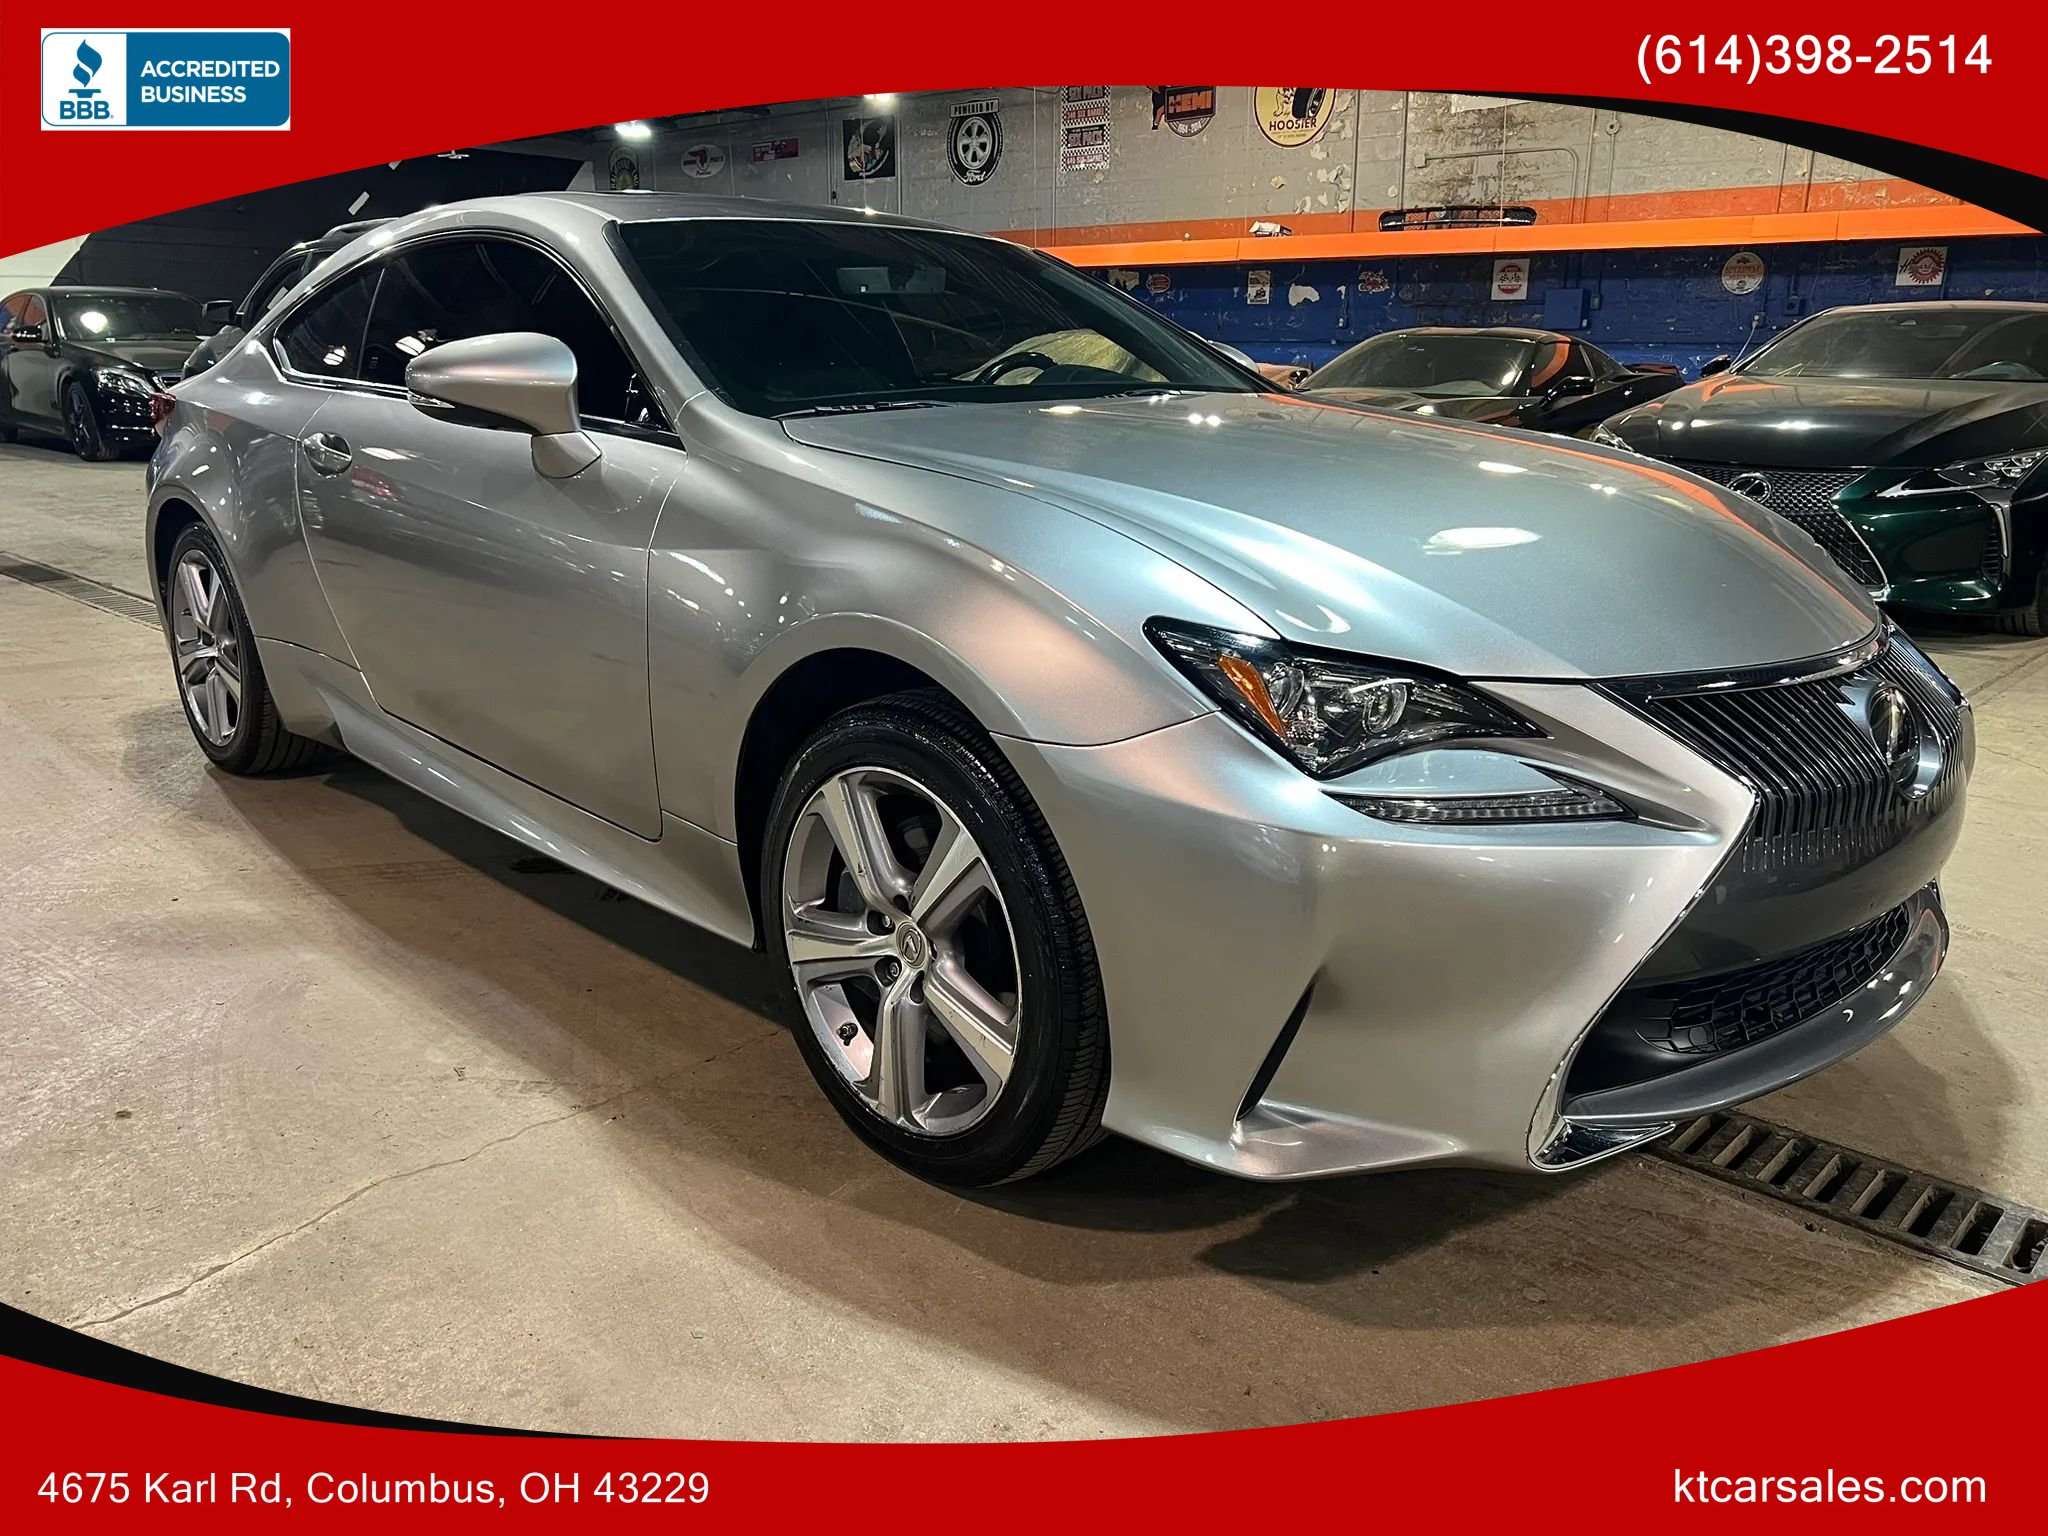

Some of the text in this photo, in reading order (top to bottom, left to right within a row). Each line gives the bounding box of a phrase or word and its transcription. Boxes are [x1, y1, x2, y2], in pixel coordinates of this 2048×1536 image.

[954, 101, 994, 115] POWERED BY
[1168, 90, 1212, 114] HEMI
[1269, 117, 1317, 131] HOOSIER
[964, 170, 986, 183] Ford
